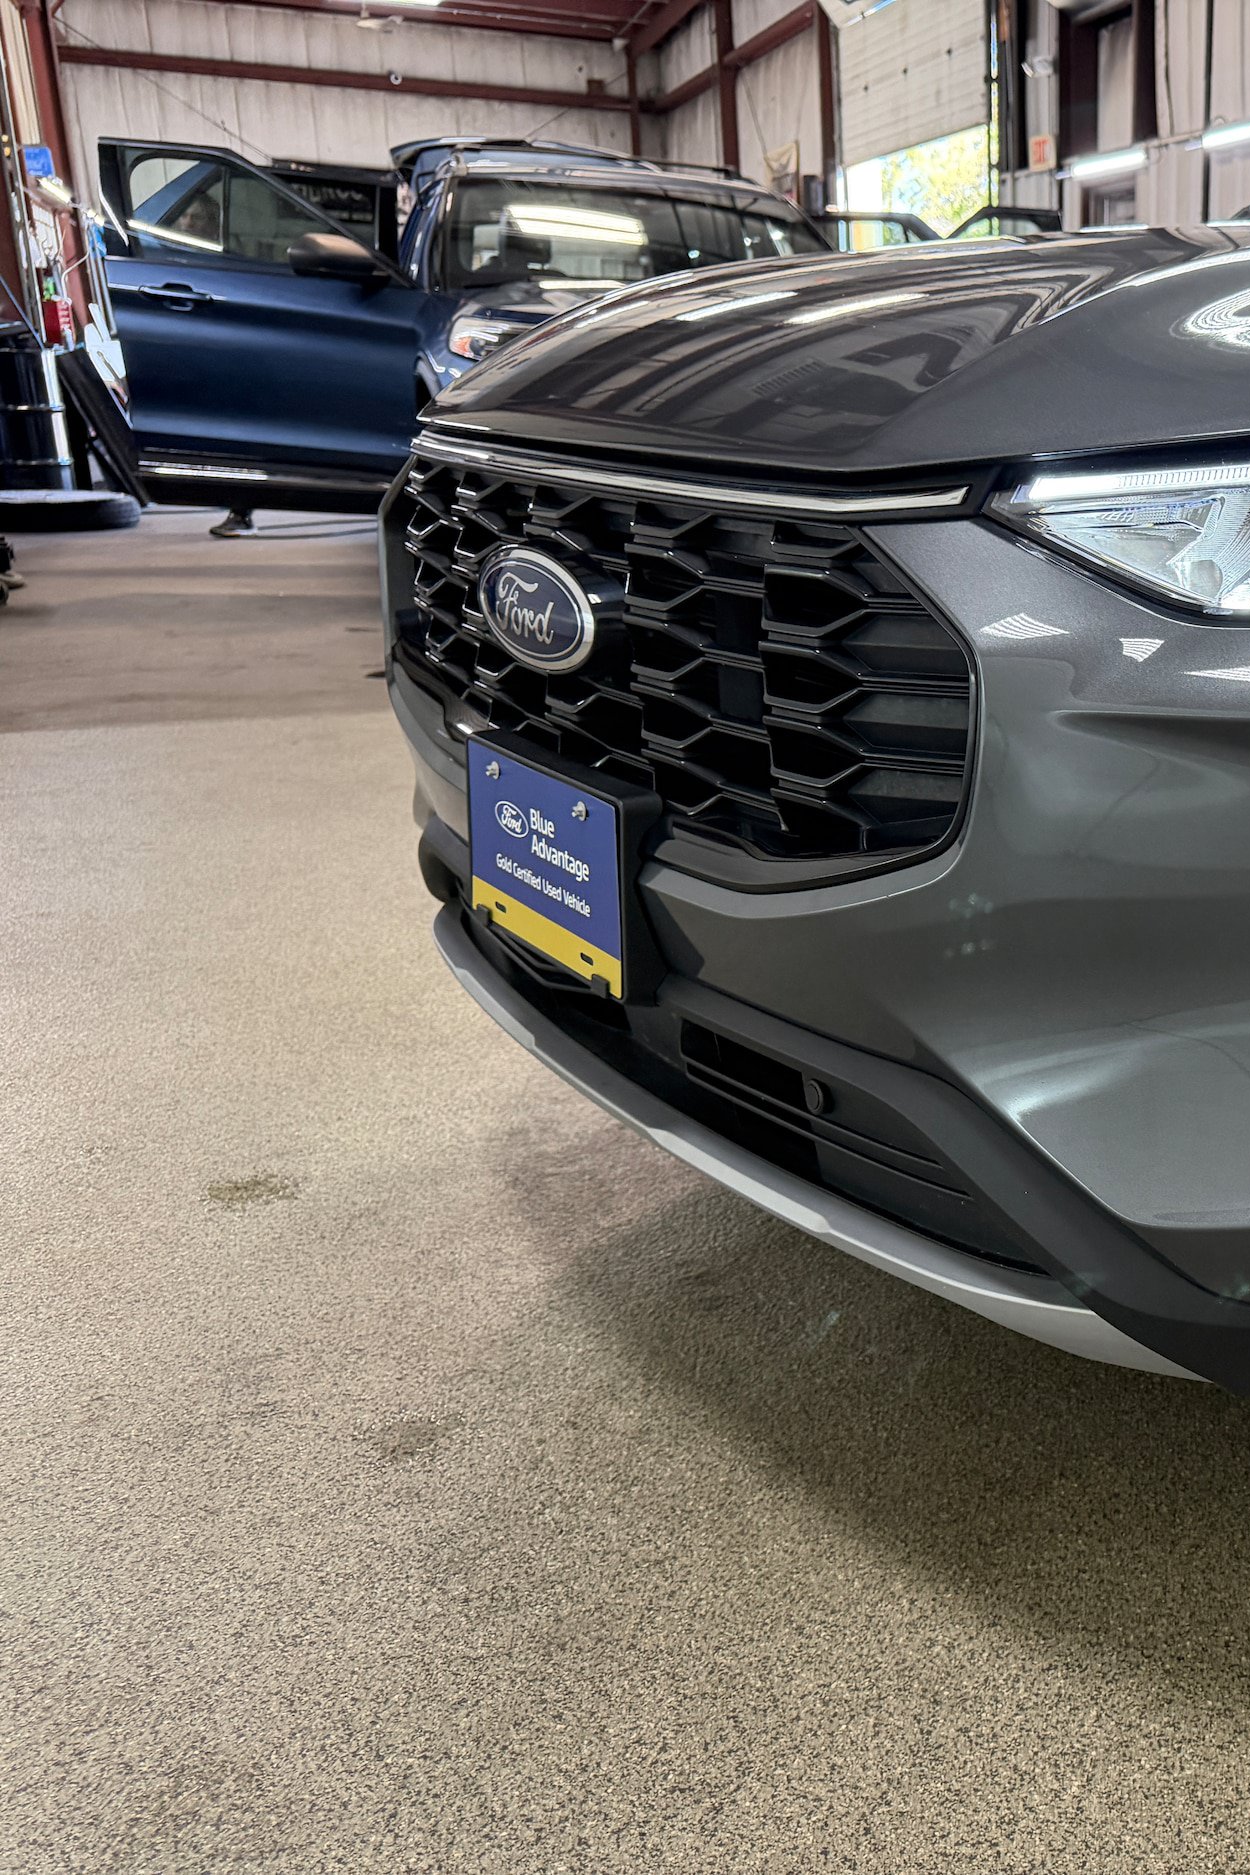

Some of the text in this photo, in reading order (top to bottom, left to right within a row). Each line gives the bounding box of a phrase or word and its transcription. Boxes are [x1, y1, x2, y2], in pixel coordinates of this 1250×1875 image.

[495, 571, 555, 645] Ford
[501, 804, 523, 834] Ford
[529, 807, 555, 839] Blue
[531, 834, 590, 882] Advantage
[496, 853, 591, 918] Gold Certified Used Vehicle
